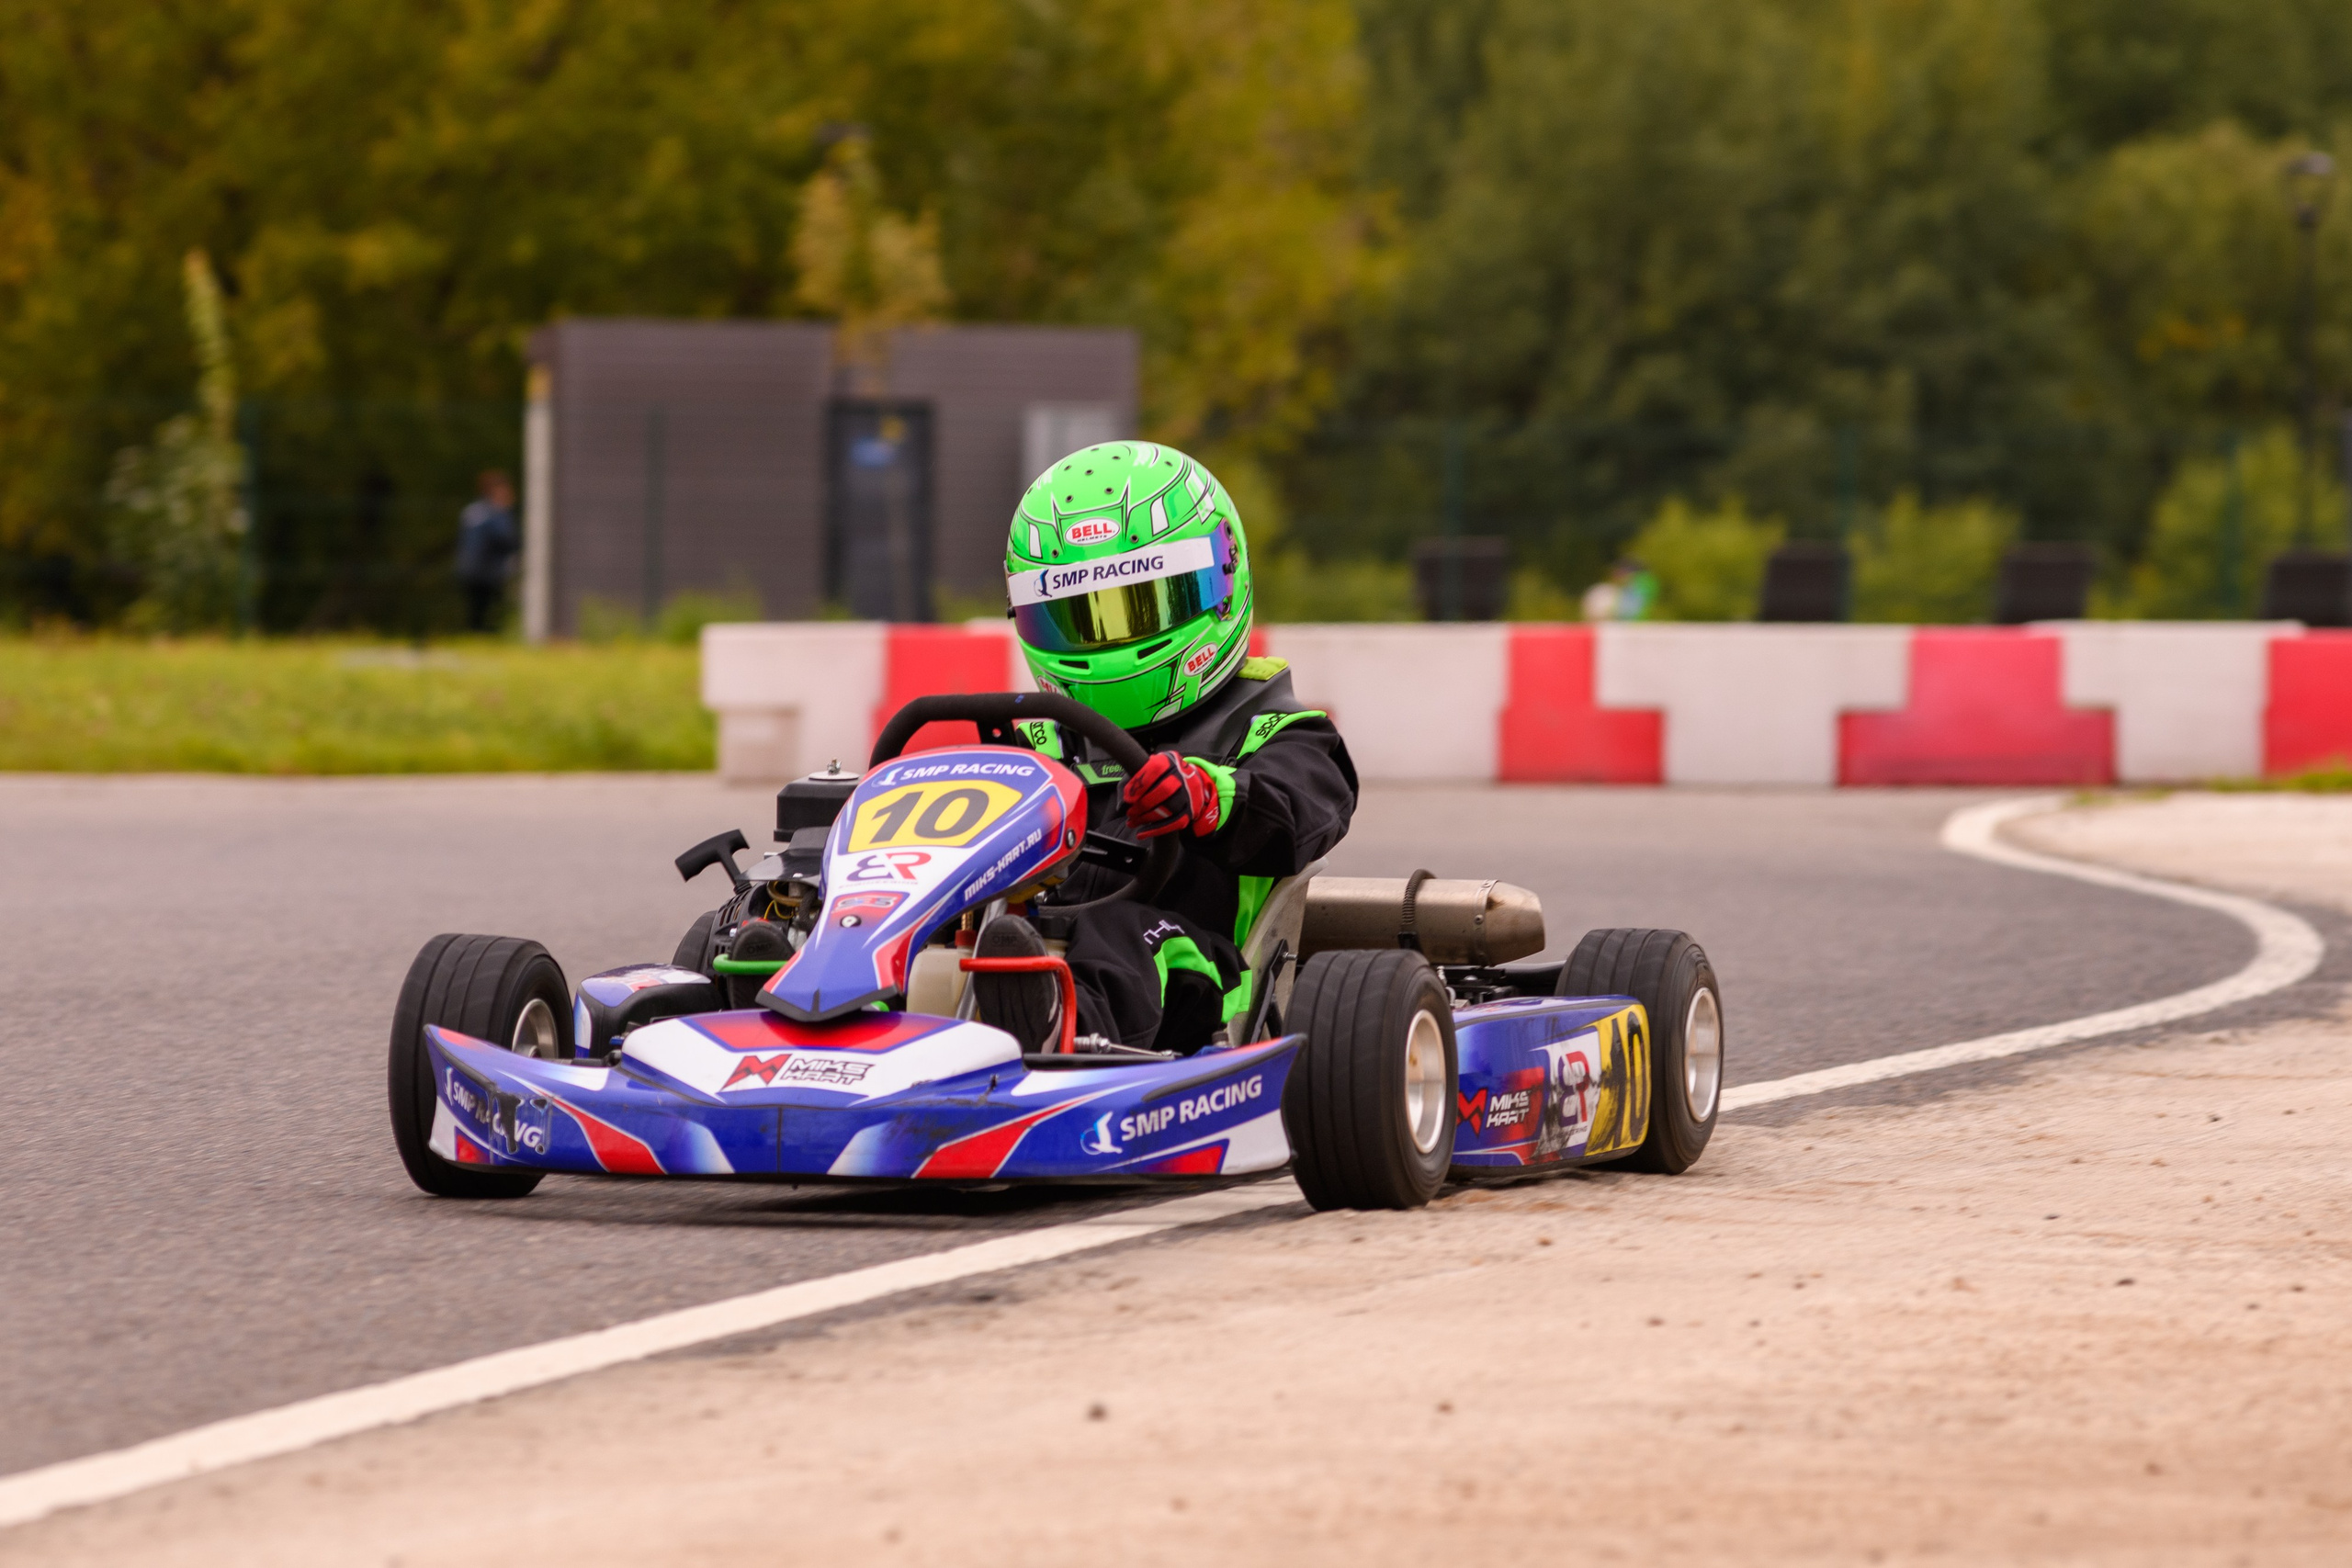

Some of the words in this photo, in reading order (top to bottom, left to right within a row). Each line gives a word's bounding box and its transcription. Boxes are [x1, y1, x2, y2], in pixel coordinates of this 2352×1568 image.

[1071, 522, 1113, 539] BELL
[1053, 570, 1089, 591] SMP
[1092, 555, 1164, 581] RACING
[1187, 647, 1216, 672] BELL
[899, 764, 949, 781] SMP
[950, 763, 1035, 777] RACING
[868, 788, 990, 845] 10
[964, 828, 1042, 902] MIKS-KART.RU
[780, 1070, 865, 1086] KART
[790, 1058, 876, 1075] MIKS
[1610, 1010, 1648, 1148] 10
[1120, 1105, 1175, 1142] SMP
[1179, 1074, 1262, 1124] RACING
[1489, 1090, 1531, 1112] MIKS
[1486, 1108, 1530, 1129] KART
